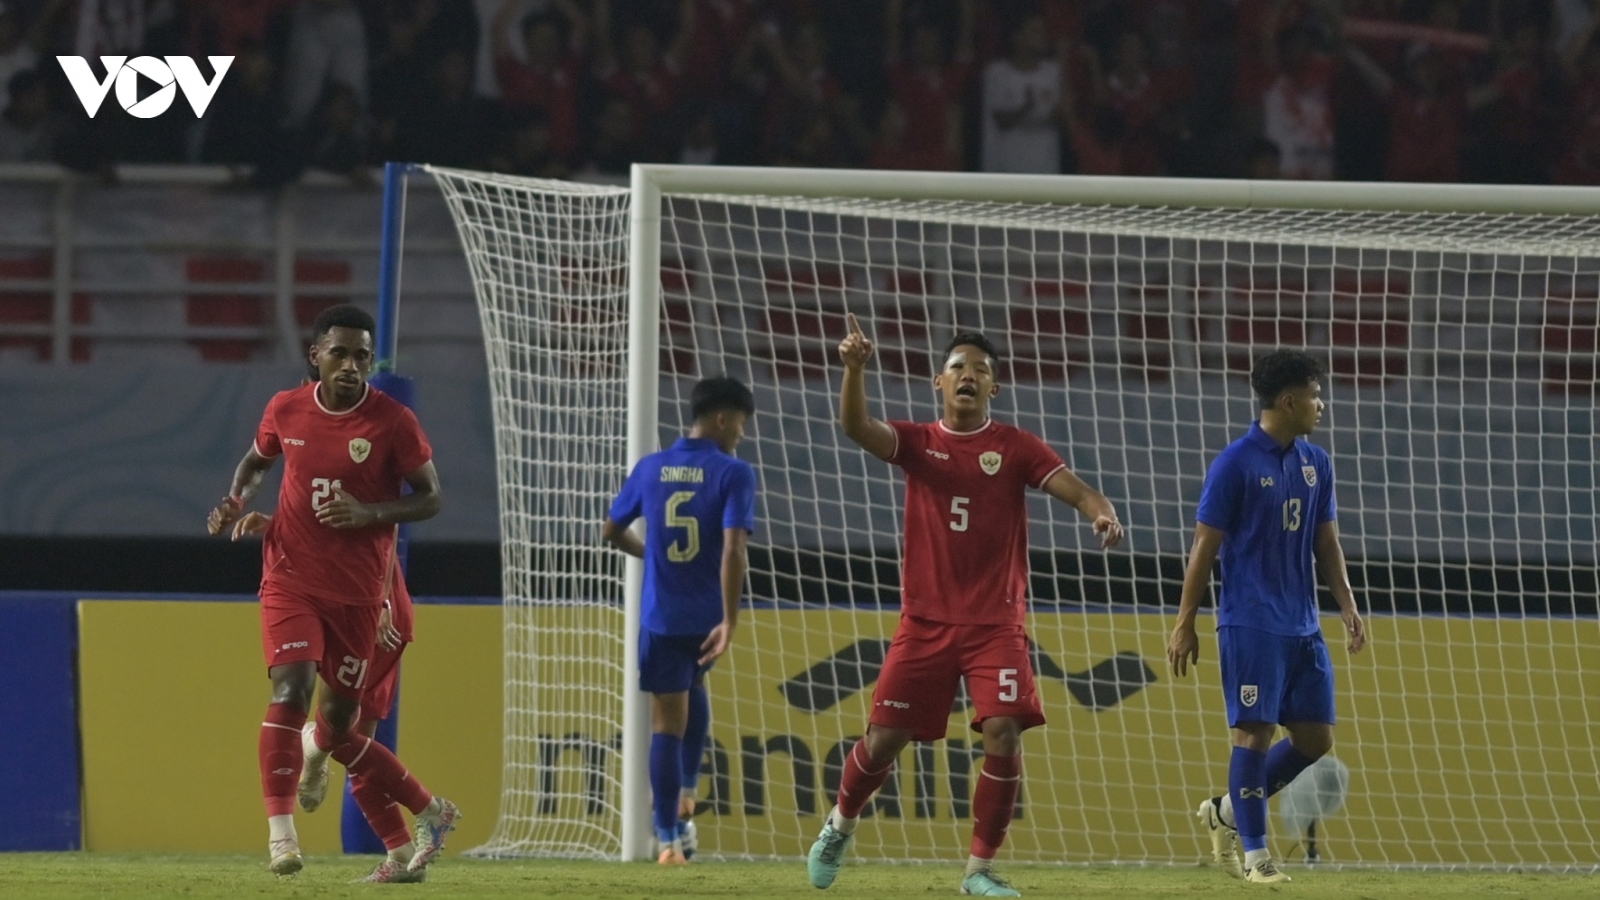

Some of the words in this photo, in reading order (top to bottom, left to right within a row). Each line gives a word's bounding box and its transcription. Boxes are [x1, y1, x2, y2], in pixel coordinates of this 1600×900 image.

[283, 437, 305, 446] erspo
[925, 448, 949, 460] erspo
[660, 466, 704, 483] SINGHA
[665, 491, 700, 562] 5
[950, 496, 970, 532] 5
[1282, 498, 1301, 531] 13
[281, 640, 308, 650] erspo
[336, 655, 368, 689] 21
[998, 668, 1018, 702] 5
[883, 700, 910, 709] erspo
[538, 730, 1024, 819] manir
